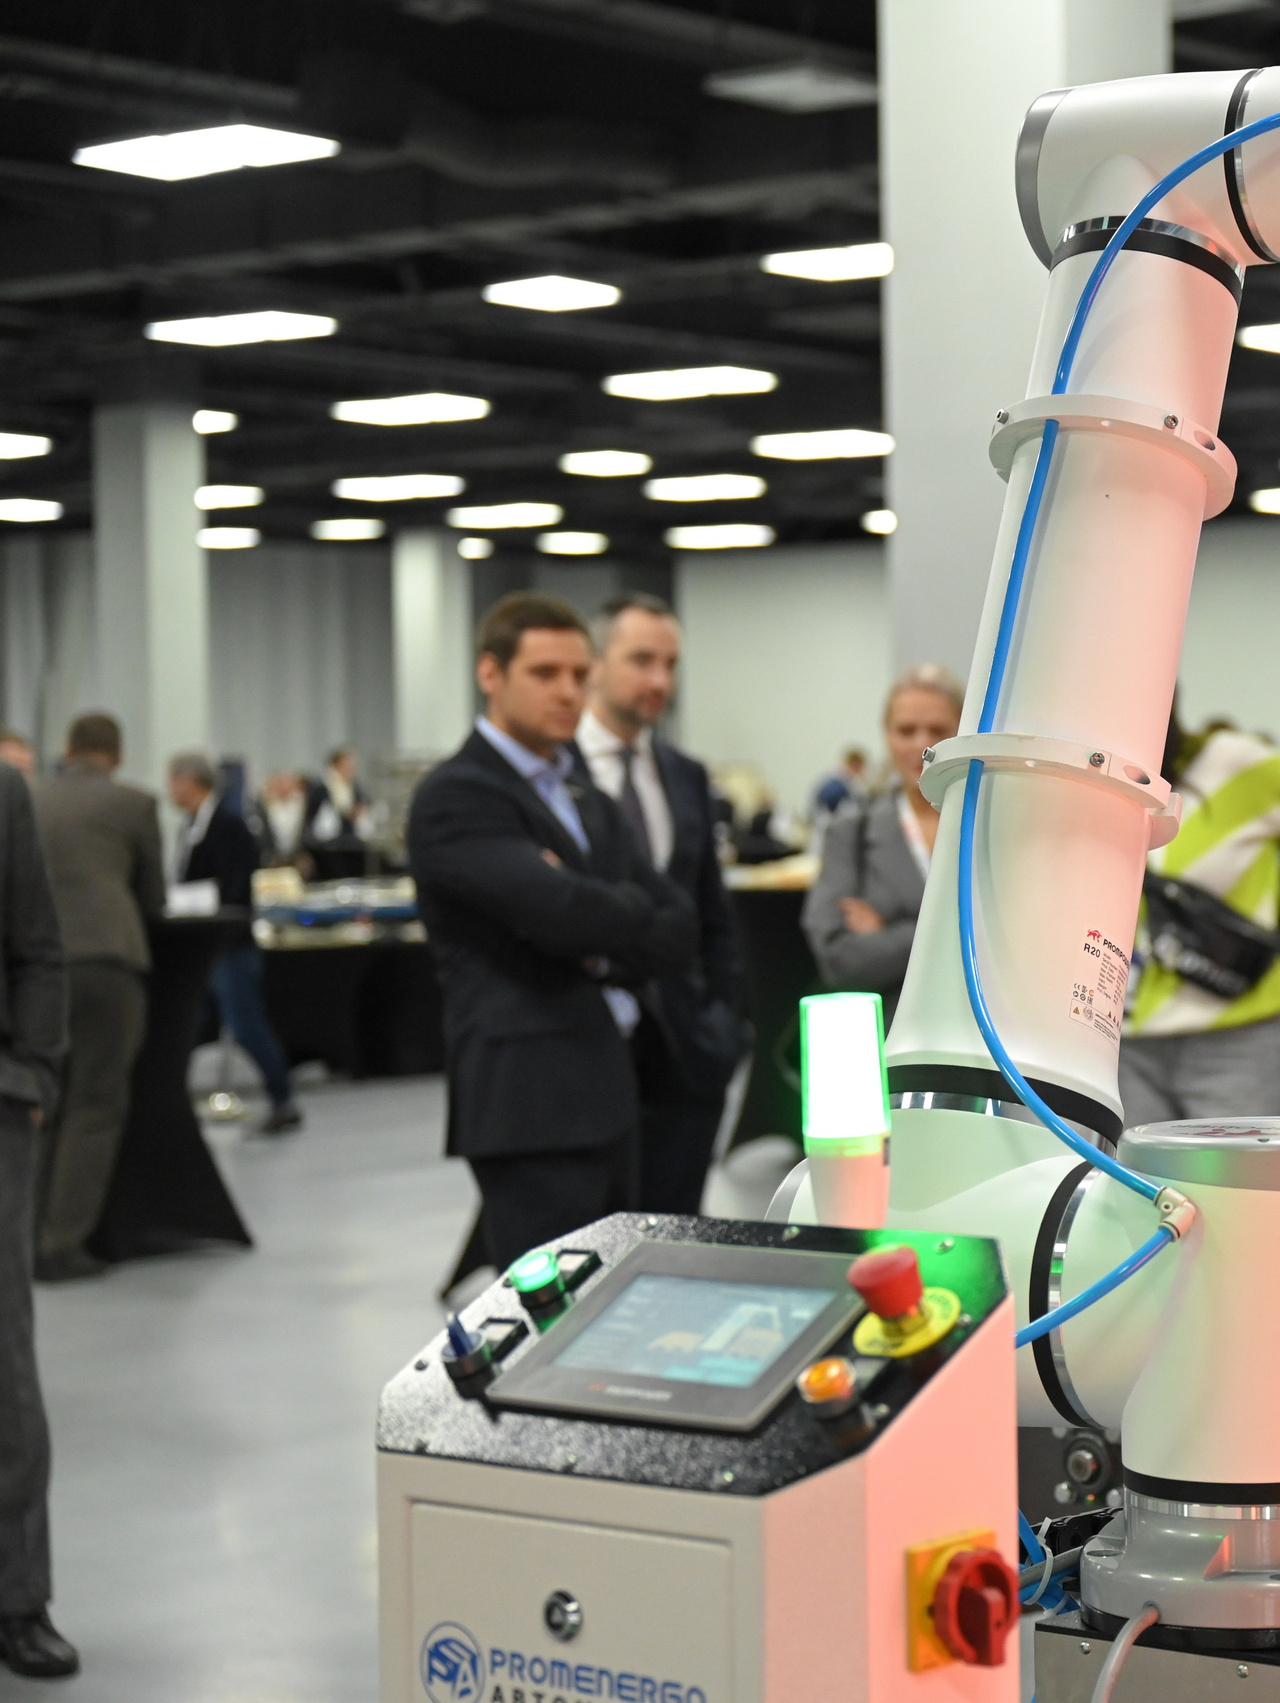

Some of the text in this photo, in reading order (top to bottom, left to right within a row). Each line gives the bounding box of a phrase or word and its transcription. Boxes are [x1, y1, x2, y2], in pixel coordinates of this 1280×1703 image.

[1083, 942, 1101, 958] R20
[1103, 938, 1131, 969] PROMPO
[489, 1647, 707, 1703] PROMENERGO
